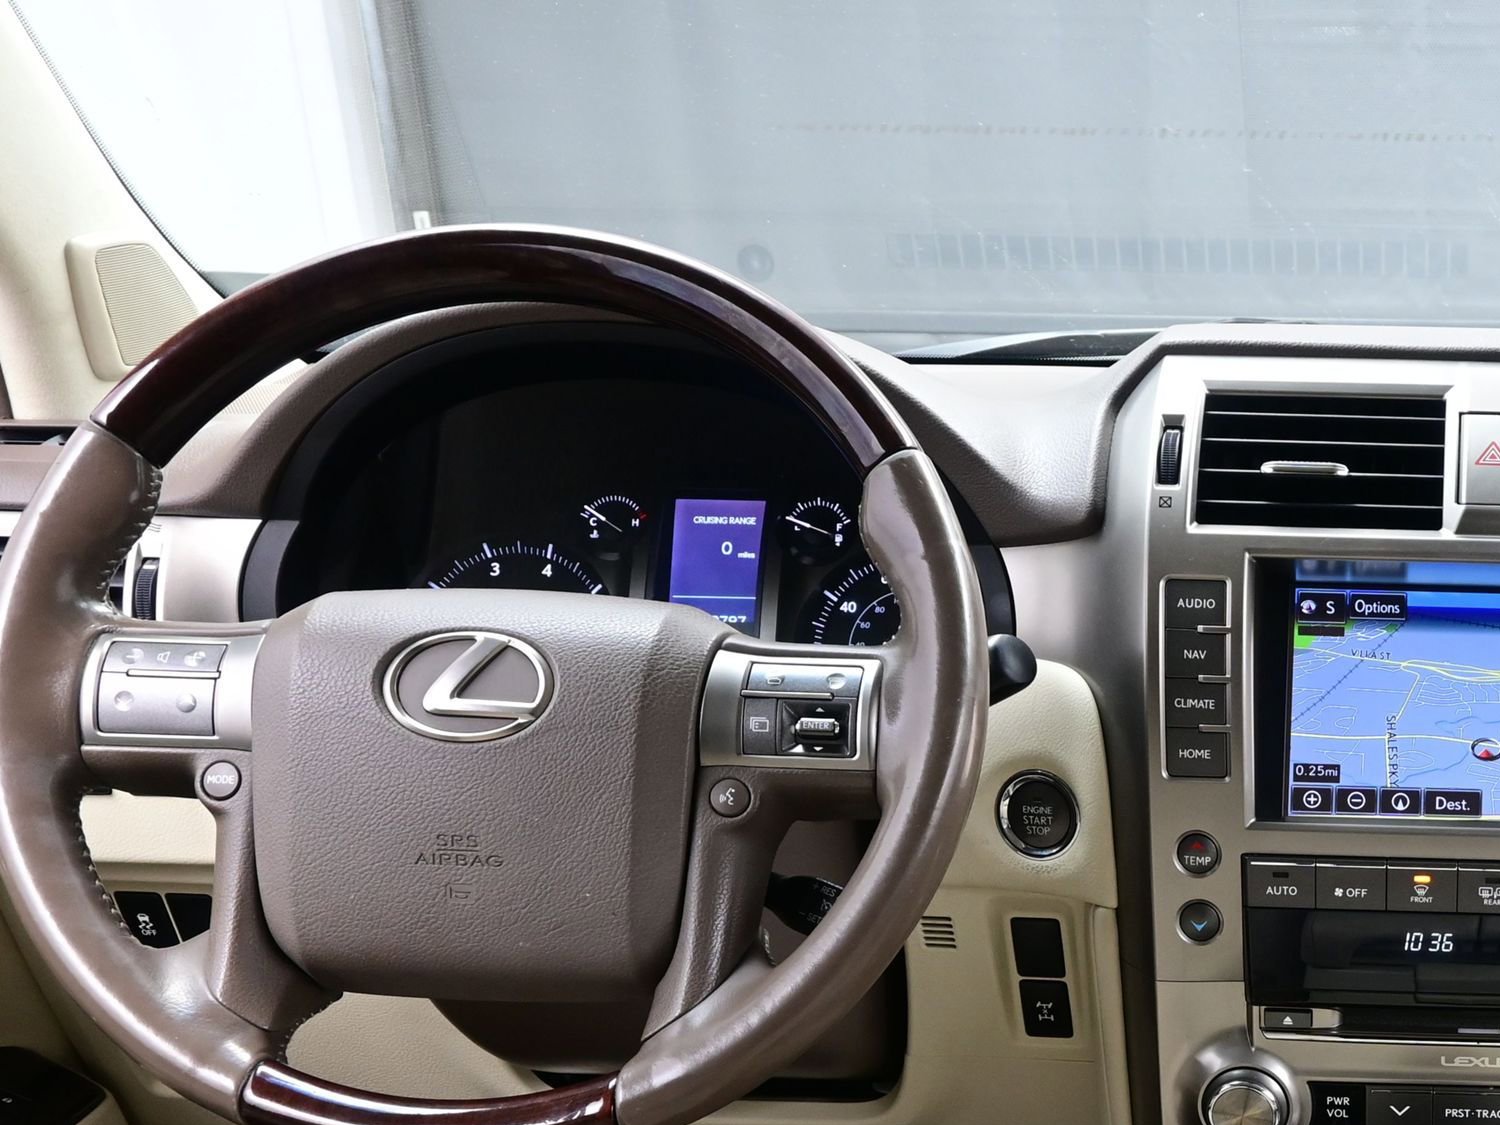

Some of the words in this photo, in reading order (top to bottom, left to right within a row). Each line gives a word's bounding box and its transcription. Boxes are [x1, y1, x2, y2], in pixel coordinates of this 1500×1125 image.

[589, 516, 598, 527] C
[631, 518, 640, 527] H
[693, 515, 728, 525] CRUISING
[729, 516, 757, 525] RANGE
[836, 523, 843, 532] F
[721, 541, 733, 555] 0
[489, 562, 501, 577] 3
[541, 564, 553, 578] 4
[839, 601, 857, 614] 40
[1176, 598, 1216, 609] AUDIO
[1354, 599, 1401, 616] Options
[874, 606, 886, 614] 80
[859, 621, 871, 629] 60
[1183, 649, 1207, 660] NAV
[1174, 697, 1216, 709] CLIMATE
[802, 721, 831, 730] ENTER
[1178, 748, 1212, 760] HOME
[1295, 765, 1338, 777] 0.25mi
[206, 774, 236, 785] MODE
[1435, 796, 1471, 811] Dest.
[1022, 805, 1054, 815] ENGINE
[1023, 815, 1054, 825] START
[1026, 825, 1051, 836] STOP
[436, 833, 480, 848] SRS
[414, 852, 504, 868] AIRBAG
[1183, 854, 1212, 867] TEMP
[1265, 885, 1298, 896] AUTO
[1345, 887, 1369, 899] OFF
[1410, 896, 1433, 904] FRONT
[140, 928, 157, 937] OFF
[1326, 1096, 1350, 1106] PWR
[1326, 1108, 1349, 1119] VOL
